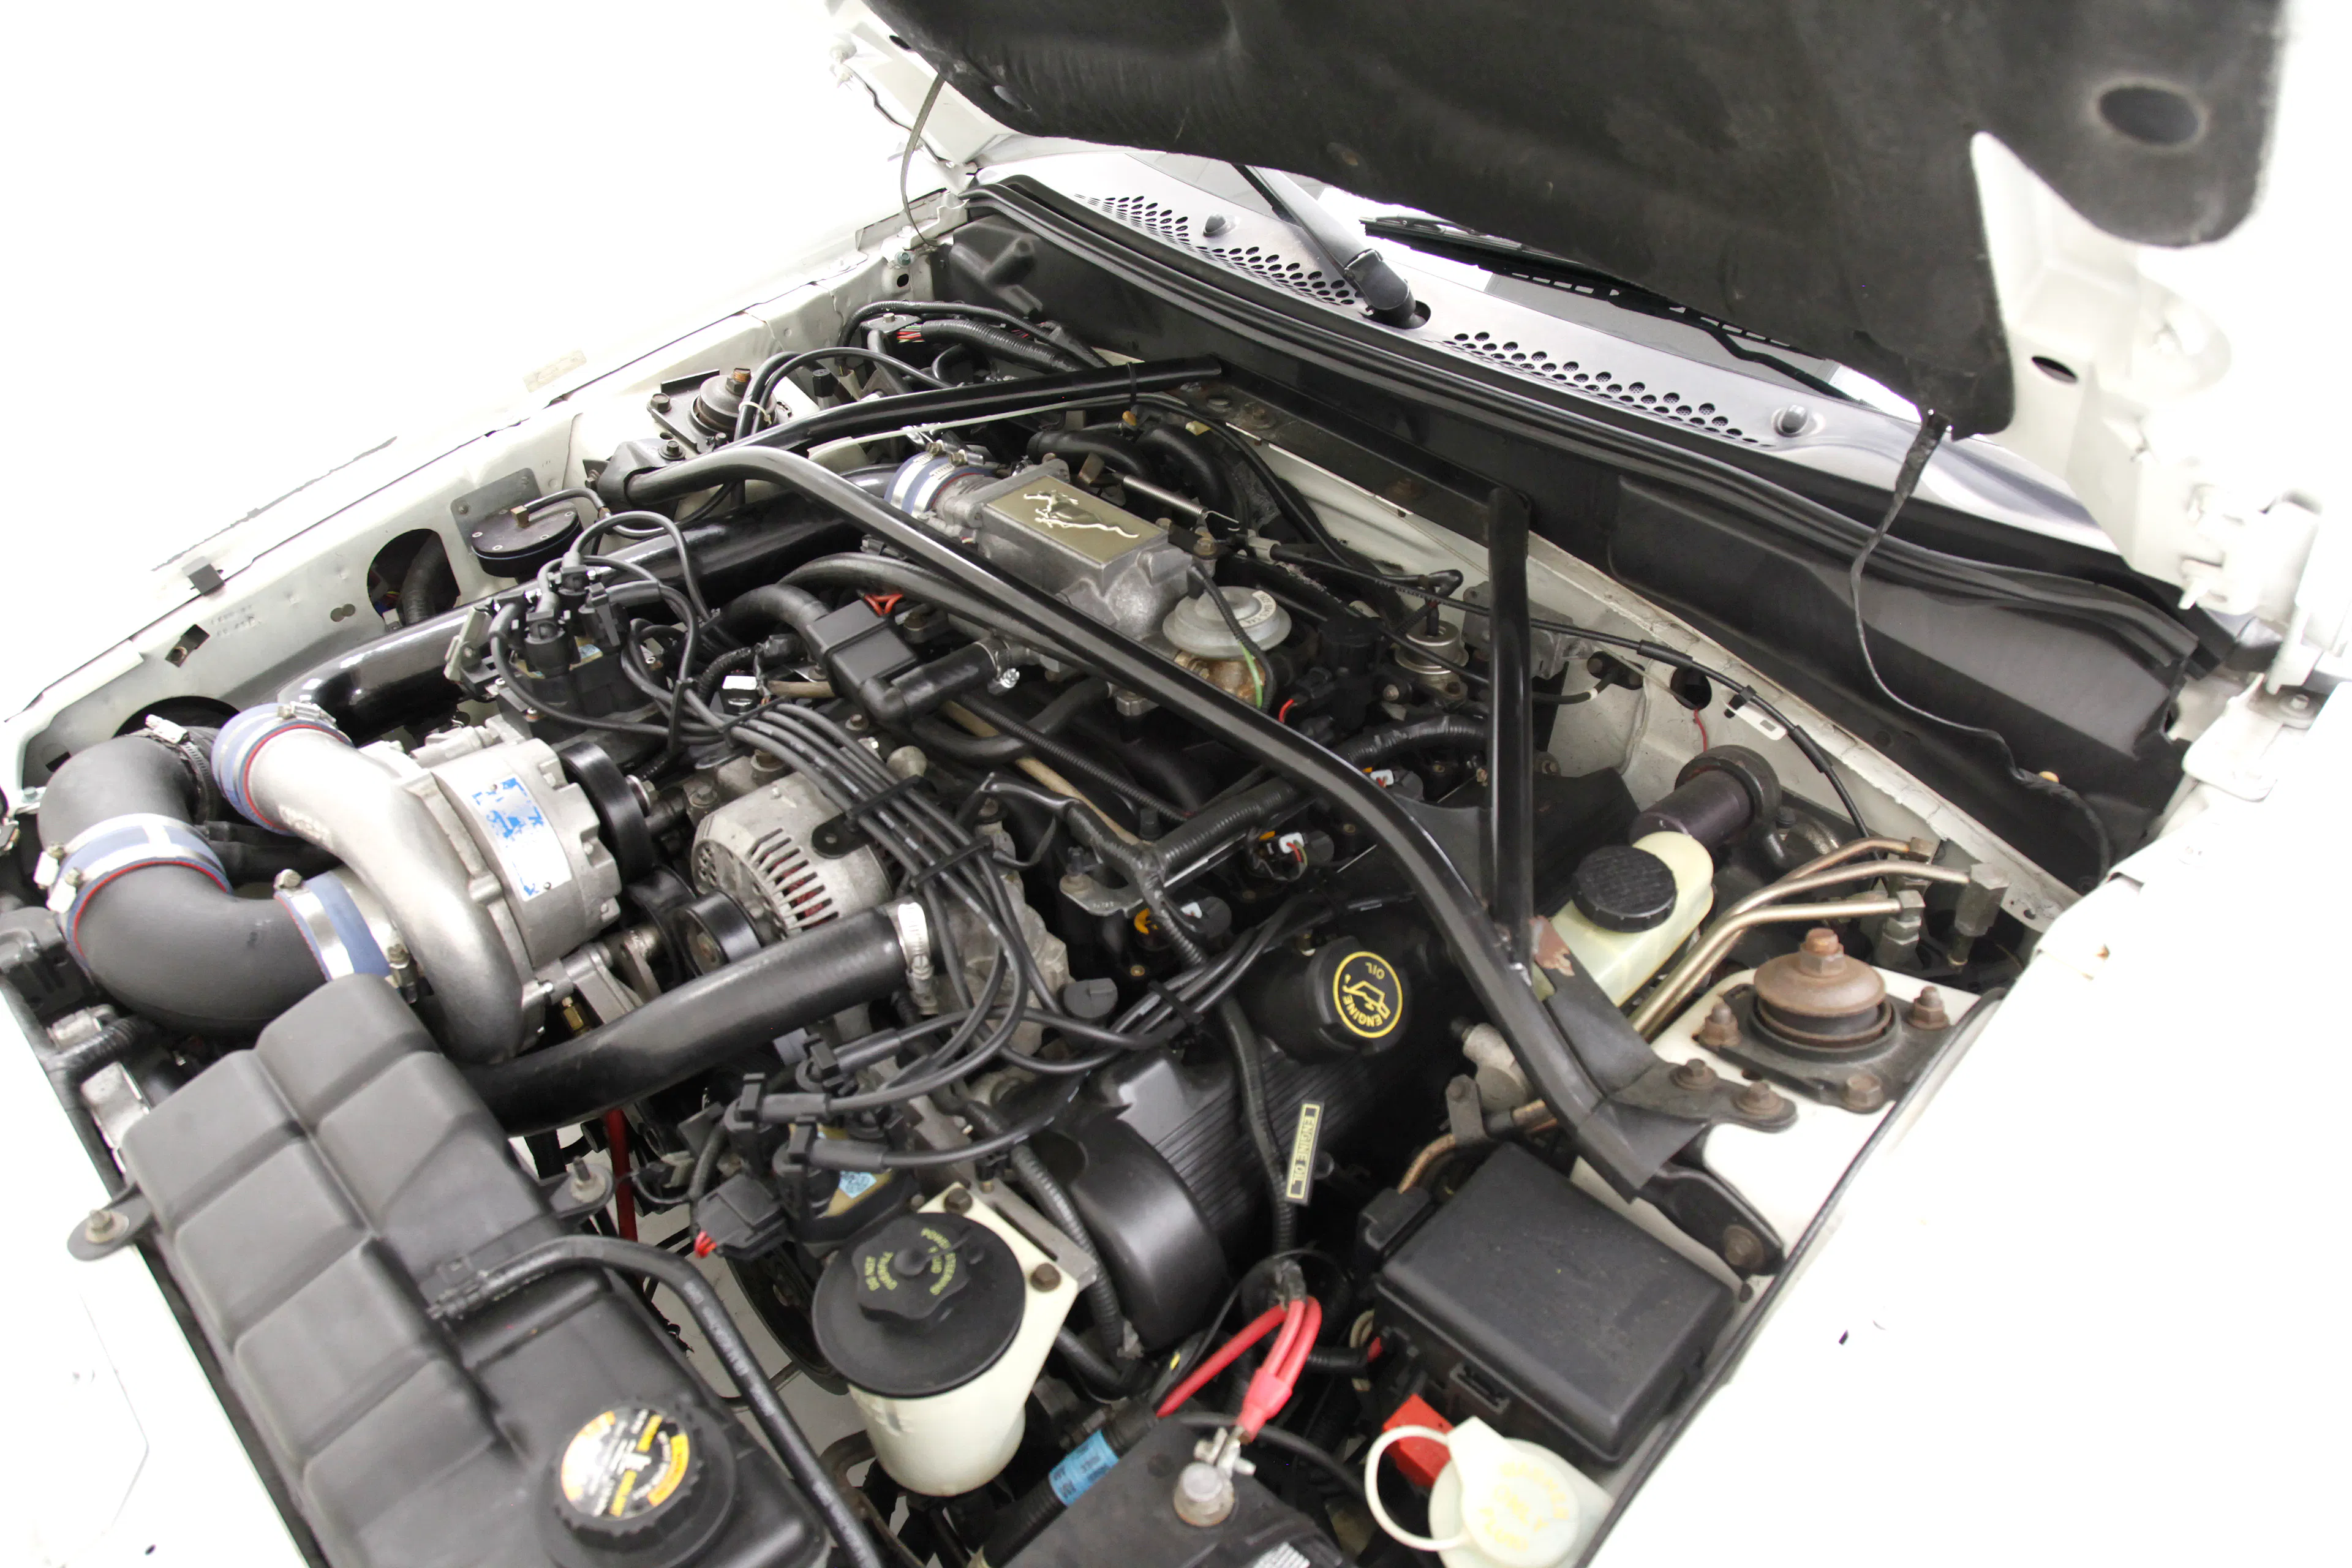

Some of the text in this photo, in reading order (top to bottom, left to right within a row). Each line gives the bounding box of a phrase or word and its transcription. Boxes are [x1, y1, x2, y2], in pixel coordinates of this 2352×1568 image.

[1365, 962, 1385, 980] OIL
[1341, 994, 1383, 1027] ENGINE
[1292, 1115, 1315, 1185] ENGINE OIL
[864, 1256, 880, 1291] DO NOT
[928, 1246, 943, 1273] FUID
